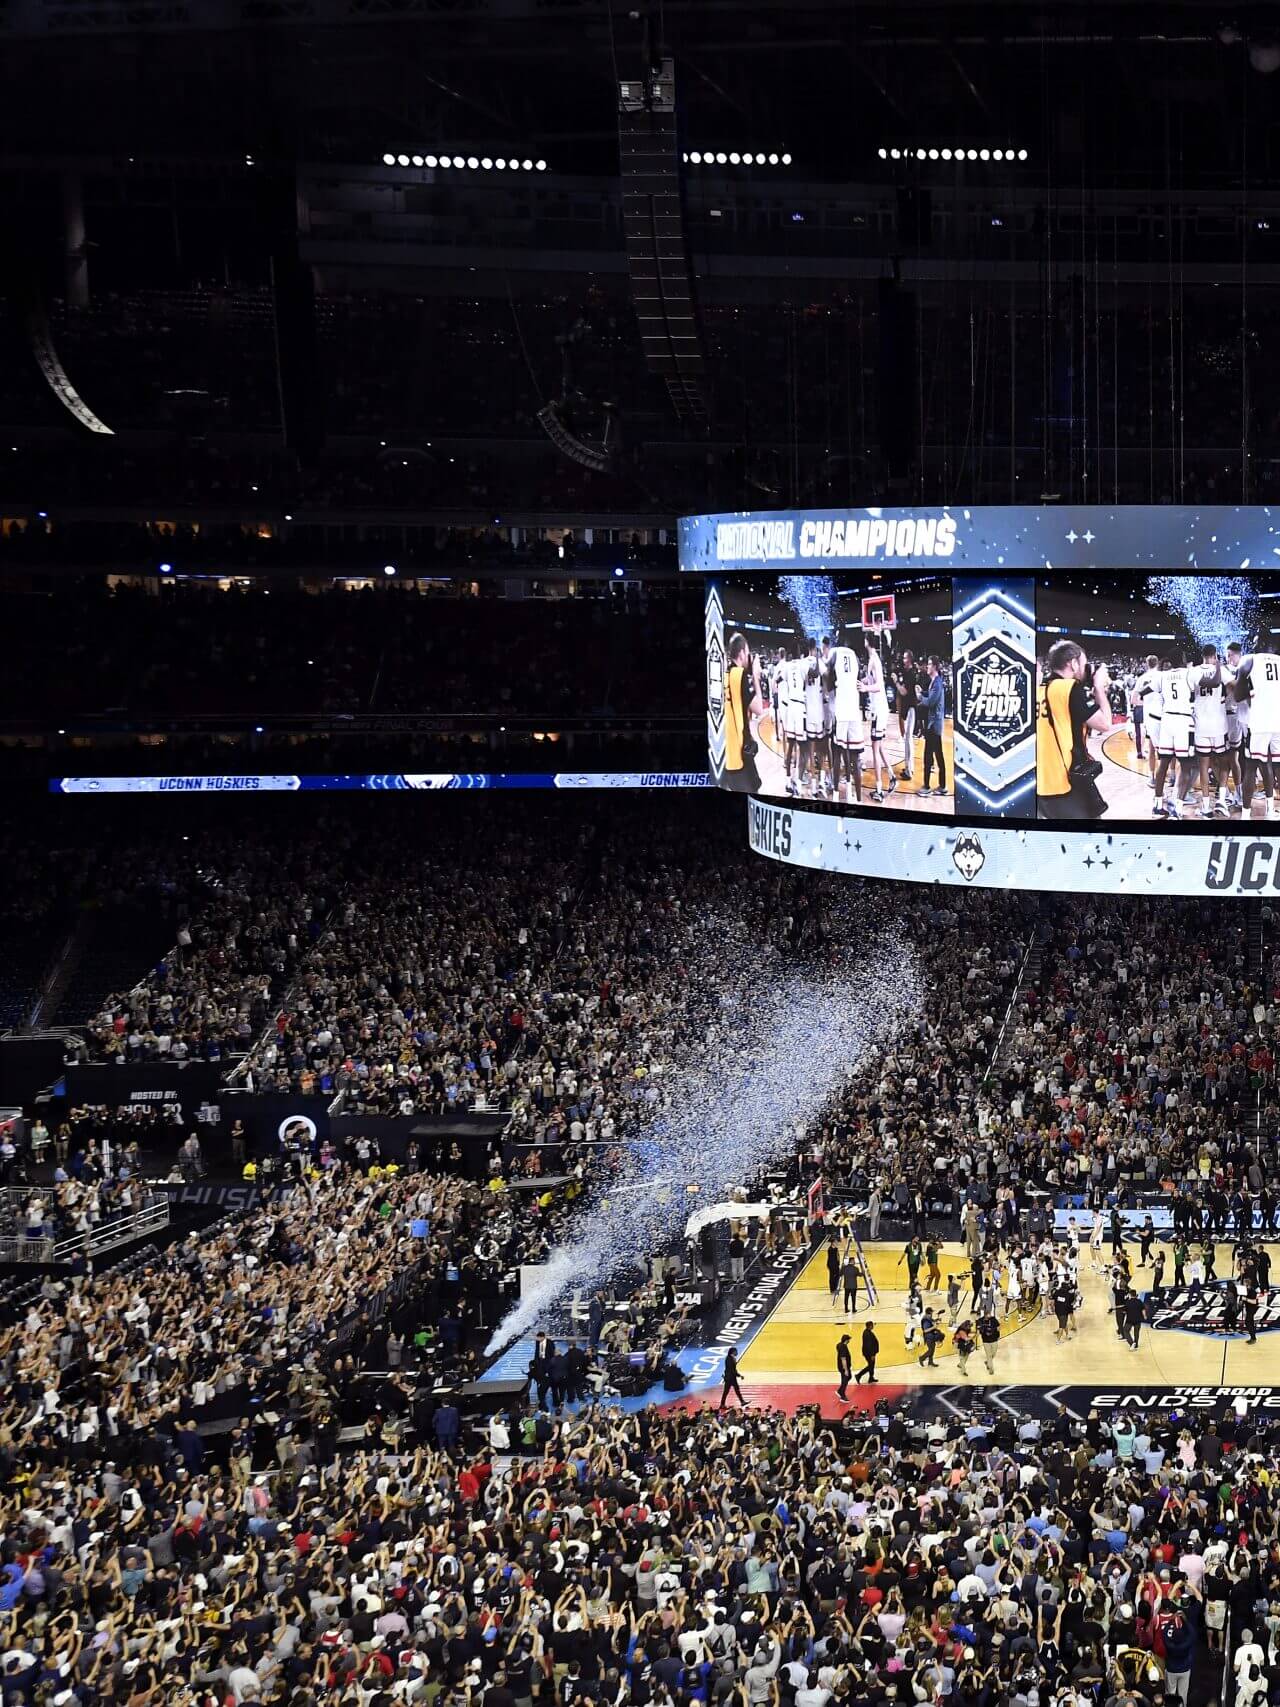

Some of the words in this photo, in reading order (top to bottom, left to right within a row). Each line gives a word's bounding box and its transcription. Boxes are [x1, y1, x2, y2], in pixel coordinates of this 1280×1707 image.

[799, 518, 957, 558] CHAMPIONS
[1265, 662, 1278, 681] 21
[971, 673, 1018, 696] FINAL
[1170, 682, 1178, 700] 5
[975, 695, 1021, 718] FOUR
[160, 778, 202, 790] UCONN
[206, 777, 260, 789] HUSKIES
[641, 774, 680, 786] UCONN
[687, 1345, 732, 1384] NCAA
[716, 1302, 764, 1343] MEN'S
[748, 1270, 789, 1309] FINAL
[1174, 1387, 1213, 1396] THE
[1216, 1387, 1272, 1396] ROAD
[1090, 1395, 1219, 1407] ENDS
